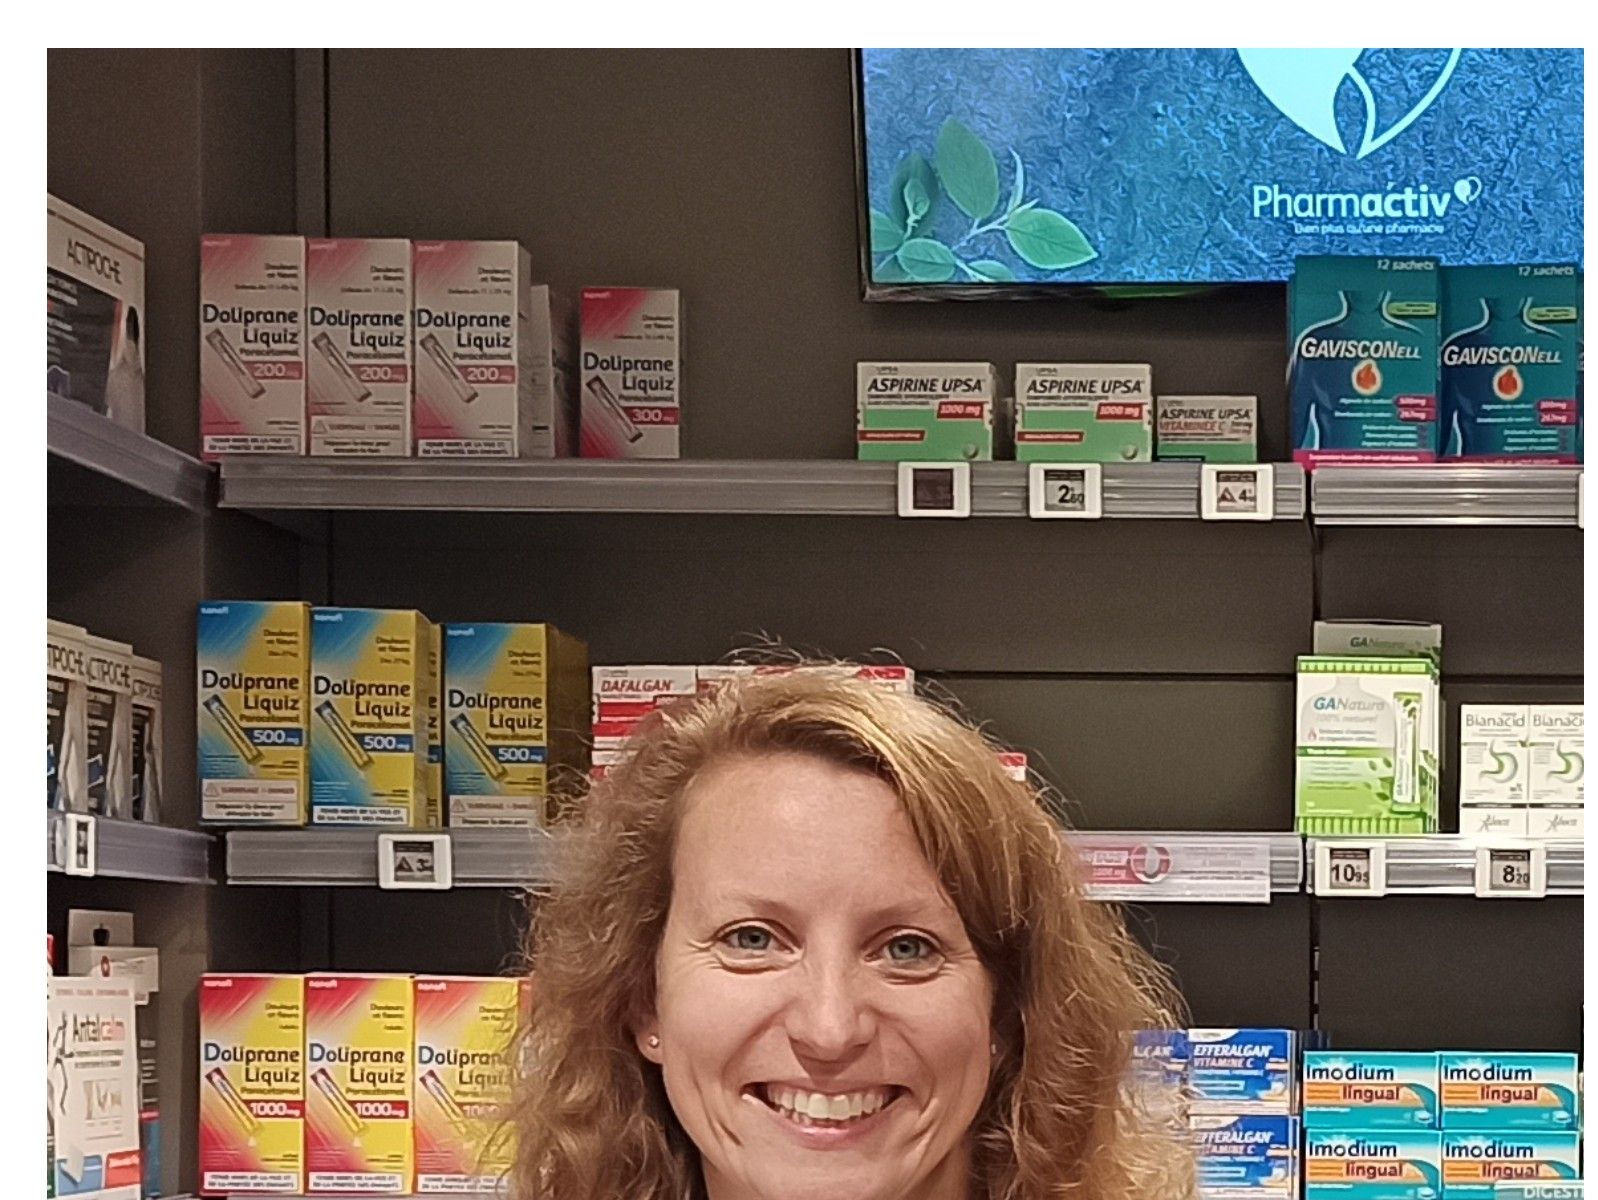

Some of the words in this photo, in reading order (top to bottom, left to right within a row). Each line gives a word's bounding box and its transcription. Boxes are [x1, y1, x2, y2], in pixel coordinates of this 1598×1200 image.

[1253, 184, 1450, 218] Pharmactiv
[203, 304, 299, 328] Doliprane
[310, 307, 405, 330] Doliprane
[417, 309, 511, 331] Doliprane
[243, 328, 299, 348] Liquiz
[350, 330, 405, 350] Liquiz
[457, 333, 512, 353] Liquiz
[253, 365, 285, 377] 200
[583, 352, 673, 374] Doliprane
[360, 367, 392, 380] 200
[467, 368, 498, 381] 200
[622, 376, 674, 394] Liquiz
[868, 378, 937, 392] ASPIRINE
[942, 378, 983, 392] UPSA
[1027, 379, 1097, 394] ASPIRINE
[1101, 380, 1142, 394] UPSA
[632, 409, 662, 422] 300
[966, 406, 981, 416] mg
[1125, 407, 1140, 418] mg
[1160, 408, 1214, 420] ASPIRINE
[1218, 408, 1251, 420] UPSA
[202, 669, 299, 694] Doliprane
[314, 676, 411, 699] Doliprane
[601, 679, 672, 693] DAFALGAN
[244, 695, 299, 714] Liquiz
[449, 689, 543, 712] Doliprane
[355, 701, 411, 720] Liquiz
[489, 713, 543, 732] Liquiz
[1465, 713, 1526, 728] Bianacid
[252, 729, 287, 743] 500
[363, 736, 397, 750] 500
[498, 748, 529, 762] 500
[204, 1042, 300, 1066] Doliprane
[309, 1042, 405, 1066] Doliprane
[1193, 1044, 1271, 1057] EFFERALGAN
[1246, 1058, 1254, 1068] C
[1305, 1063, 1395, 1081] Imodium
[244, 1067, 300, 1086] Liquiz
[350, 1068, 405, 1087] Liquiz
[1444, 1063, 1533, 1082] Imodium
[1343, 1085, 1400, 1103] lingual
[1480, 1085, 1539, 1103] lingual
[250, 1102, 287, 1116] 1000
[355, 1102, 392, 1116] 1000
[1247, 1145, 1255, 1154] C
[1308, 1139, 1398, 1158] Imodium
[1445, 1140, 1534, 1159] Imodium
[1345, 1161, 1403, 1179] lingual
[1481, 1162, 1540, 1179] lingual
